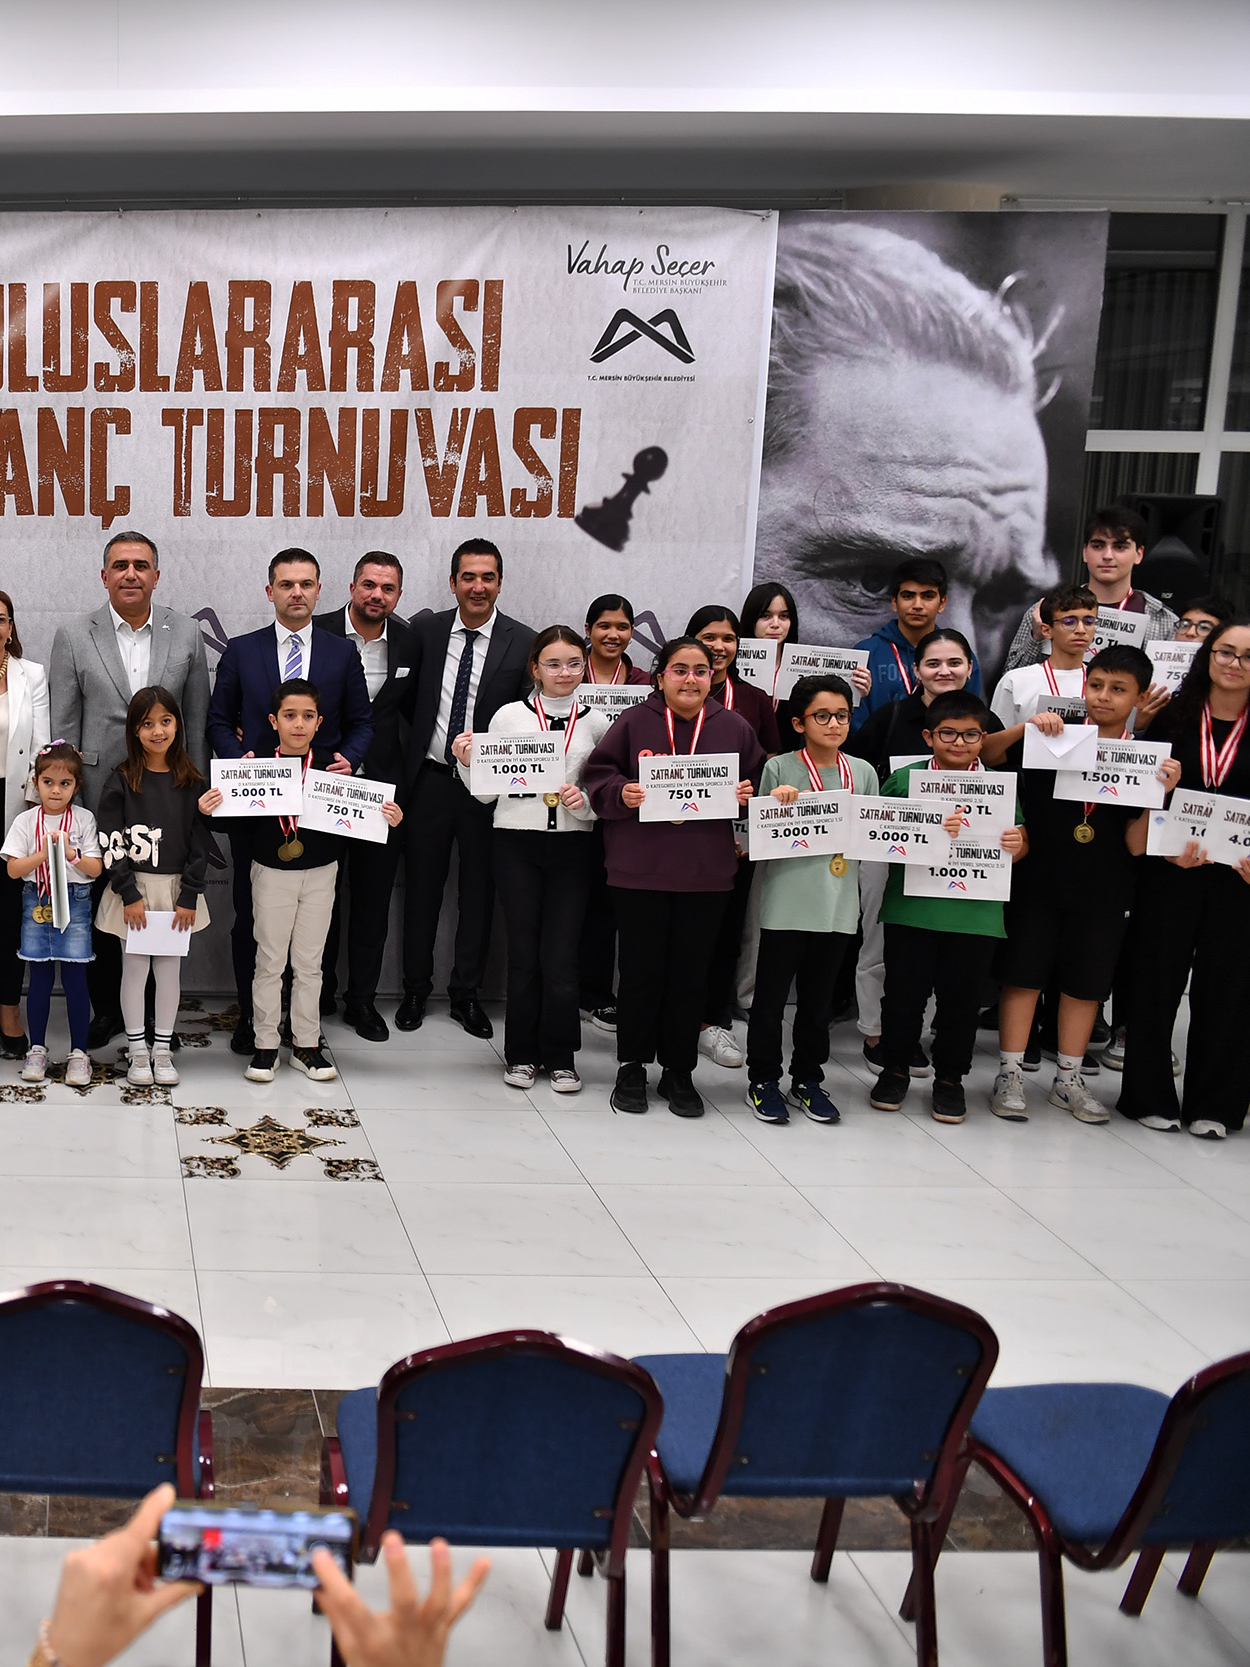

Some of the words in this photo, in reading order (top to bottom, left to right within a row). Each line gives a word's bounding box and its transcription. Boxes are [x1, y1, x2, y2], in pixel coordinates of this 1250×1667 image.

[567, 240, 644, 291] Vahap
[651, 244, 715, 278] Seçer
[161, 407, 582, 518] TURNUVASI
[743, 668, 756, 677] TL
[480, 744, 512, 755] SATRANÇ
[515, 743, 554, 754] TURNUVASI
[1111, 752, 1157, 766] TURNUVASI
[253, 768, 292, 779] TURNUVASI
[492, 764, 527, 774] 1.000
[530, 763, 544, 773] TL
[650, 768, 684, 780] SATRANÇ
[687, 766, 728, 779] TURNUVASI
[1081, 772, 1120, 784] 1.500
[1125, 775, 1140, 785] TL
[231, 788, 266, 797] 5.000
[269, 787, 283, 796] TL
[668, 789, 693, 799] 750
[696, 788, 711, 798] TL
[920, 782, 956, 795] SATRANÇ
[959, 783, 1004, 796] TURNUVASI
[346, 788, 385, 804] TURNUVASI
[326, 804, 348, 816] 750
[352, 809, 365, 819] TL
[760, 807, 794, 820] SATRANÇ
[796, 803, 839, 817] TURNUVASI
[860, 808, 896, 822] SATRANÇ
[898, 811, 943, 825] TURNUVASI
[976, 805, 992, 815] TL
[734, 823, 747, 833] TL
[771, 827, 809, 838] 3.000
[813, 825, 828, 835] TL
[869, 830, 909, 842] 9.000
[914, 833, 928, 844] TL
[956, 847, 1001, 860] TURNUVASI
[928, 867, 967, 878] 1.000
[972, 869, 987, 879] TL
